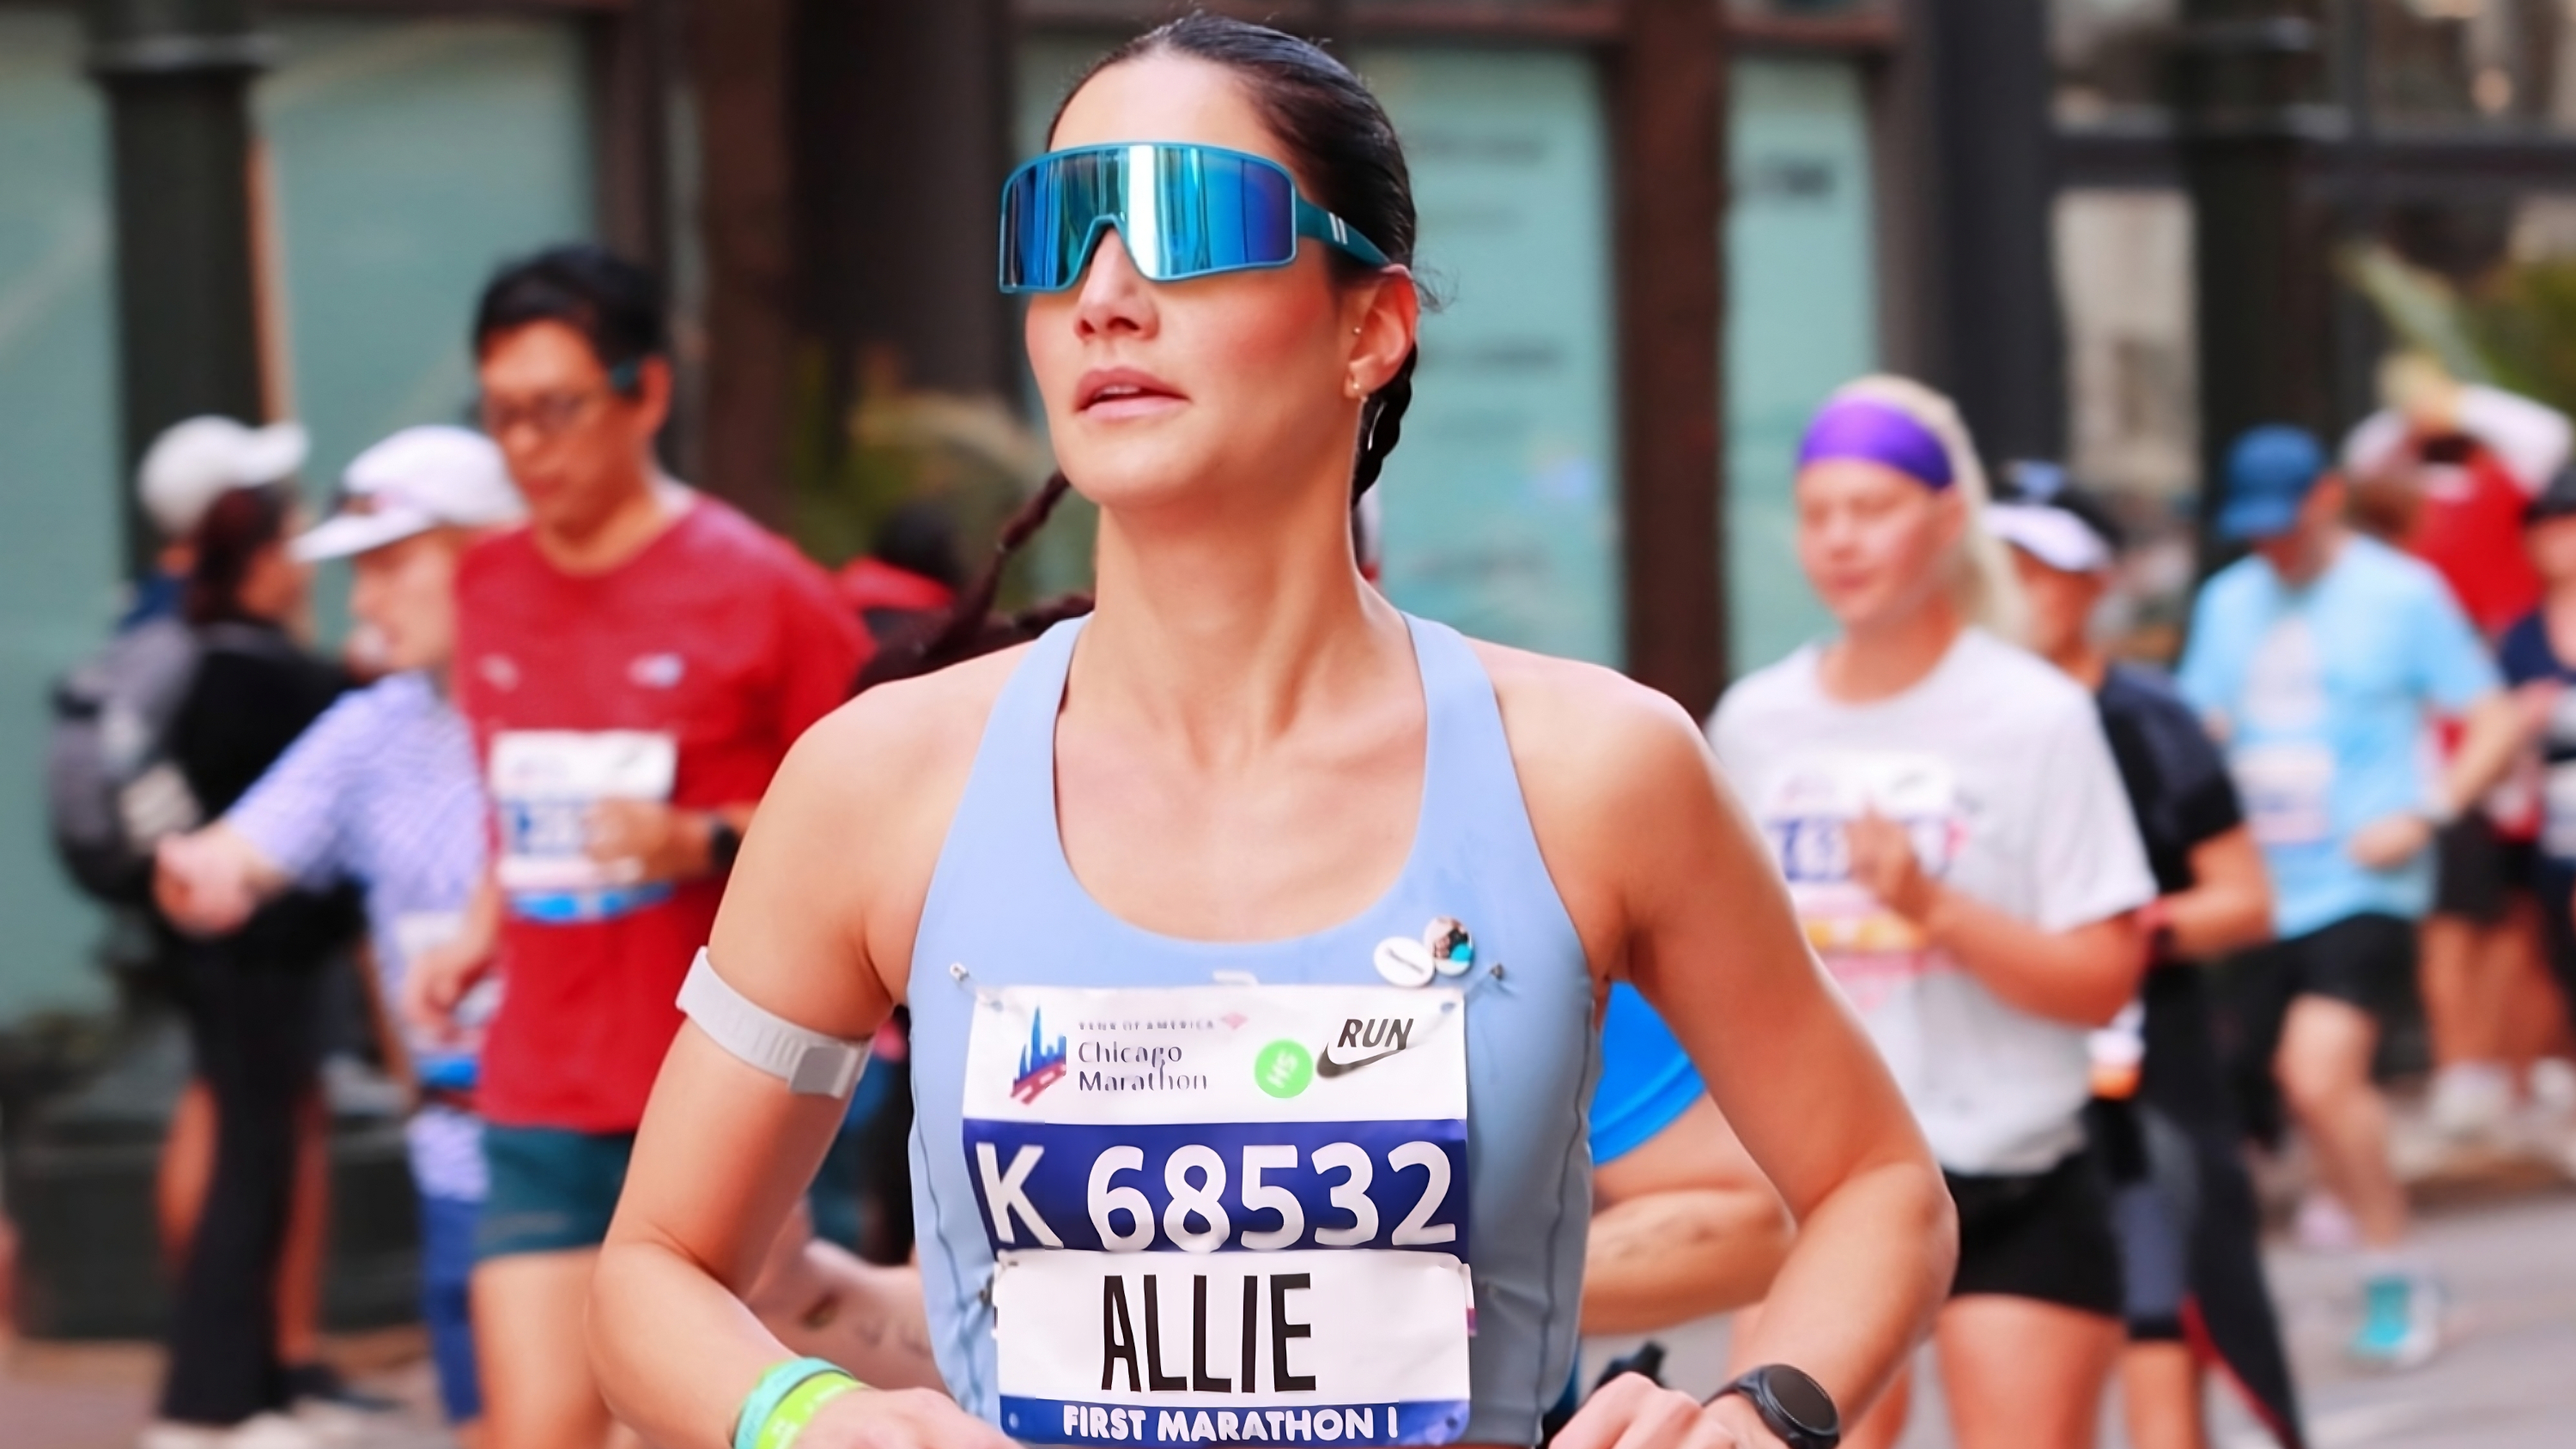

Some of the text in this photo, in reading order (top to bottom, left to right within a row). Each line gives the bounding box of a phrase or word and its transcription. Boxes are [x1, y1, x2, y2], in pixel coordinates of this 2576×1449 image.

[1337, 1018, 1414, 1050] RUN
[1078, 1040, 1182, 1068] Chicago
[1078, 1066, 1207, 1091] Marathon
[975, 1141, 1457, 1252] K 68532
[1101, 1272, 1317, 1394] ALLIE
[1062, 1405, 1146, 1440] FIRST
[1157, 1408, 1374, 1442] MARATHON
